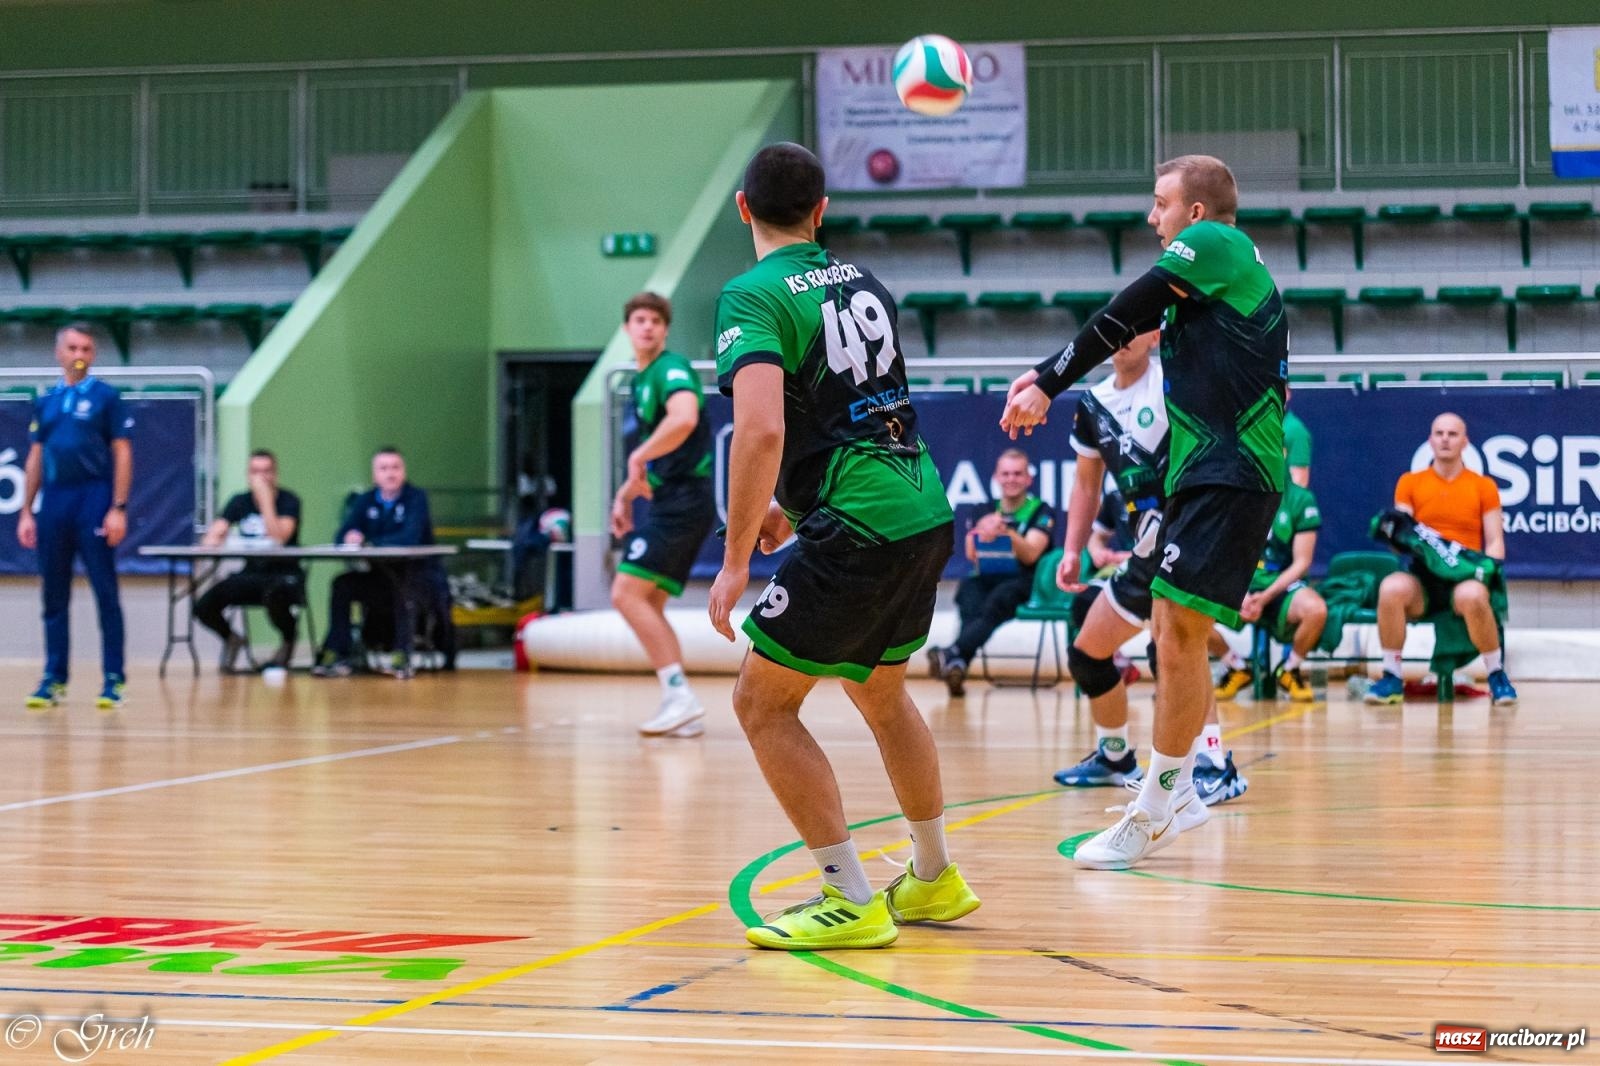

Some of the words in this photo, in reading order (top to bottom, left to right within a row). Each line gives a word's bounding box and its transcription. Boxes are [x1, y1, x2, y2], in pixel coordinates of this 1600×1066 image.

[784, 274, 809, 295] KS
[821, 290, 897, 386] 49
[627, 537, 648, 560] 9
[1160, 543, 1181, 574] 2
